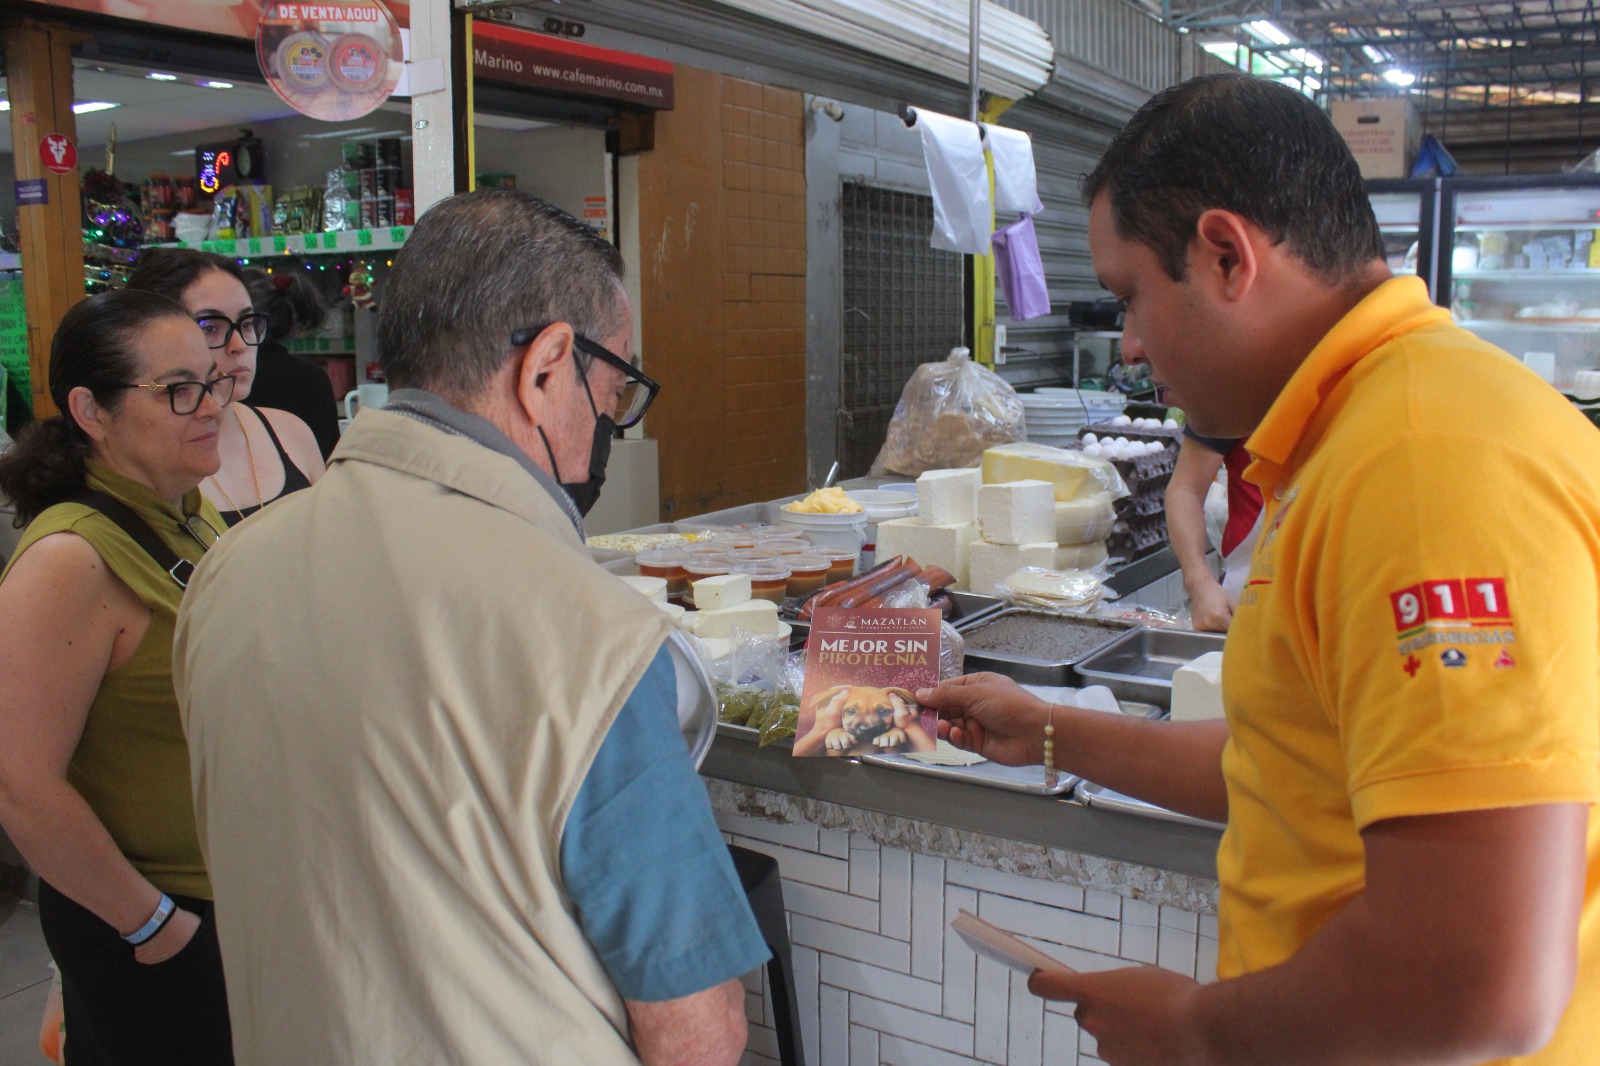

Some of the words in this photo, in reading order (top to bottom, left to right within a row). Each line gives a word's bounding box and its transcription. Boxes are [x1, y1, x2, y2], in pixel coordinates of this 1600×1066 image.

[279, 5, 298, 19] DE
[301, 6, 343, 20] VENTA
[346, 7, 377, 21] AQUI
[474, 48, 523, 73] Marino
[533, 63, 664, 98] www.cafemarino.com.mx
[1397, 582, 1498, 624] 911
[861, 616, 927, 626] MAZATLÁN
[820, 638, 888, 653] MEJOR
[894, 639, 928, 653] SIN
[818, 652, 928, 666] PIROTECNIA
